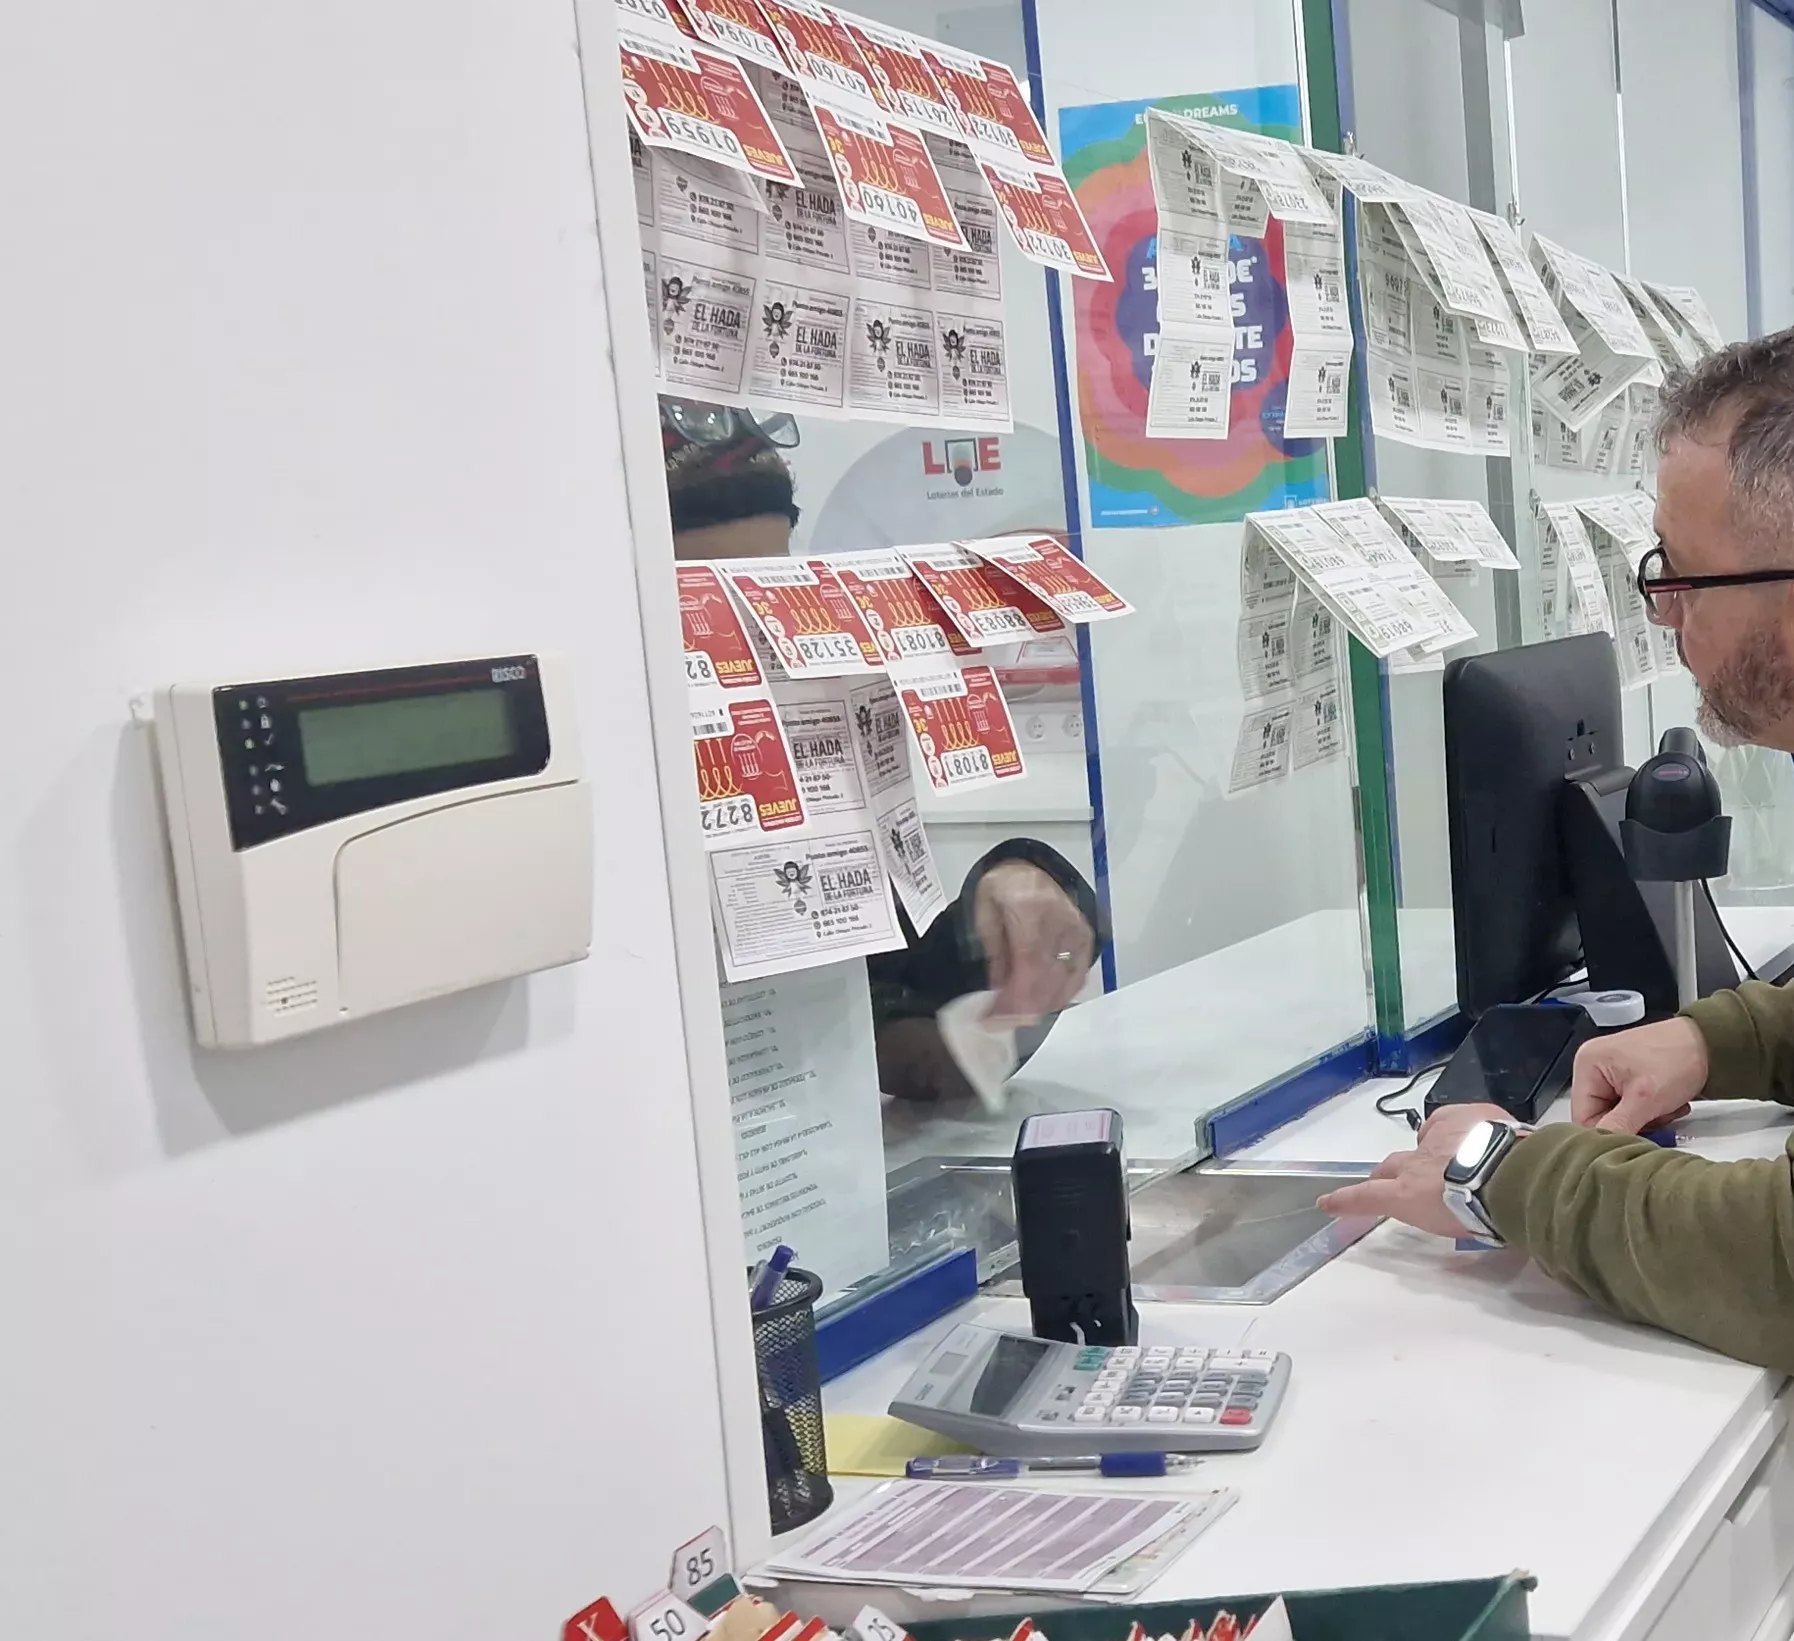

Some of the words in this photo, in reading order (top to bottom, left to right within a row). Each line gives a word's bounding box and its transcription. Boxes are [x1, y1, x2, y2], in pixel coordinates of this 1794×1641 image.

[713, 20, 778, 59] 57094
[811, 59, 866, 95] 40160
[902, 96, 953, 126] 26115
[666, 116, 737, 153] 01959
[973, 119, 1018, 149] 30122
[809, 193, 836, 216] HADA
[864, 190, 917, 222] 40160
[1028, 234, 1071, 260] 30122
[694, 303, 706, 321] EL
[710, 306, 740, 328] HADA
[796, 326, 807, 343] EL
[811, 328, 837, 350] HADA
[907, 341, 930, 358] HADA
[981, 351, 1001, 366] HADA
[976, 611, 1026, 633] 88083
[800, 639, 858, 659] 35128
[897, 632, 946, 650] 81081
[715, 659, 753, 673] JUEVES
[793, 743, 807, 759] EL
[810, 739, 843, 757] HADA
[991, 750, 1017, 765] JUEVES
[945, 753, 989, 777] 81081
[759, 798, 797, 816] JUEVES
[820, 874, 837, 892] EL
[837, 868, 872, 889] HADA
[686, 1547, 715, 1587] 85
[650, 1609, 685, 1641] 50
